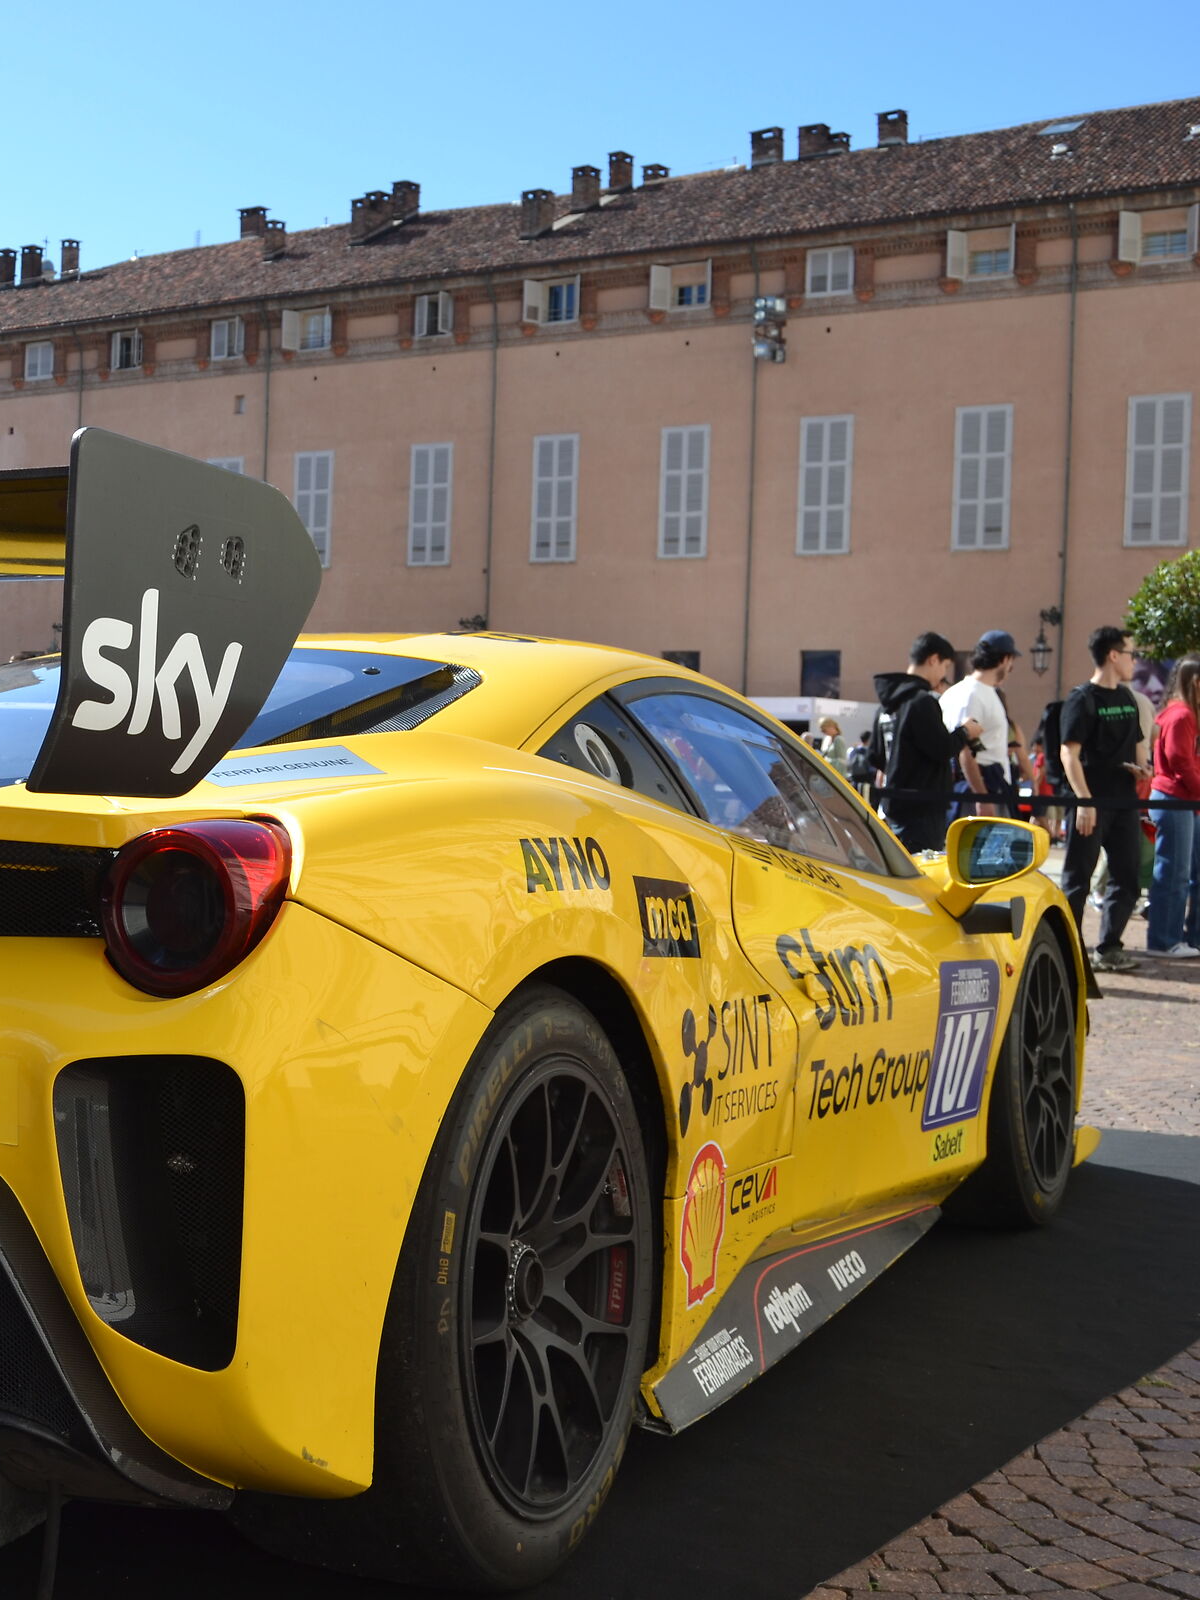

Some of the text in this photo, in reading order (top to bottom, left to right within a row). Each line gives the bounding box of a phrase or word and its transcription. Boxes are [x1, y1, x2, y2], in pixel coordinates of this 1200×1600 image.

[72, 588, 242, 774] sky
[211, 757, 354, 779] FERRARI GENUINE
[519, 836, 611, 893] AYNO
[645, 896, 692, 942] mca
[717, 994, 773, 1081] SINT
[927, 1010, 991, 1117] 107
[712, 1080, 779, 1128] IT SERVICES
[808, 1047, 931, 1120] Tech Group
[827, 1250, 867, 1292] IVECO
